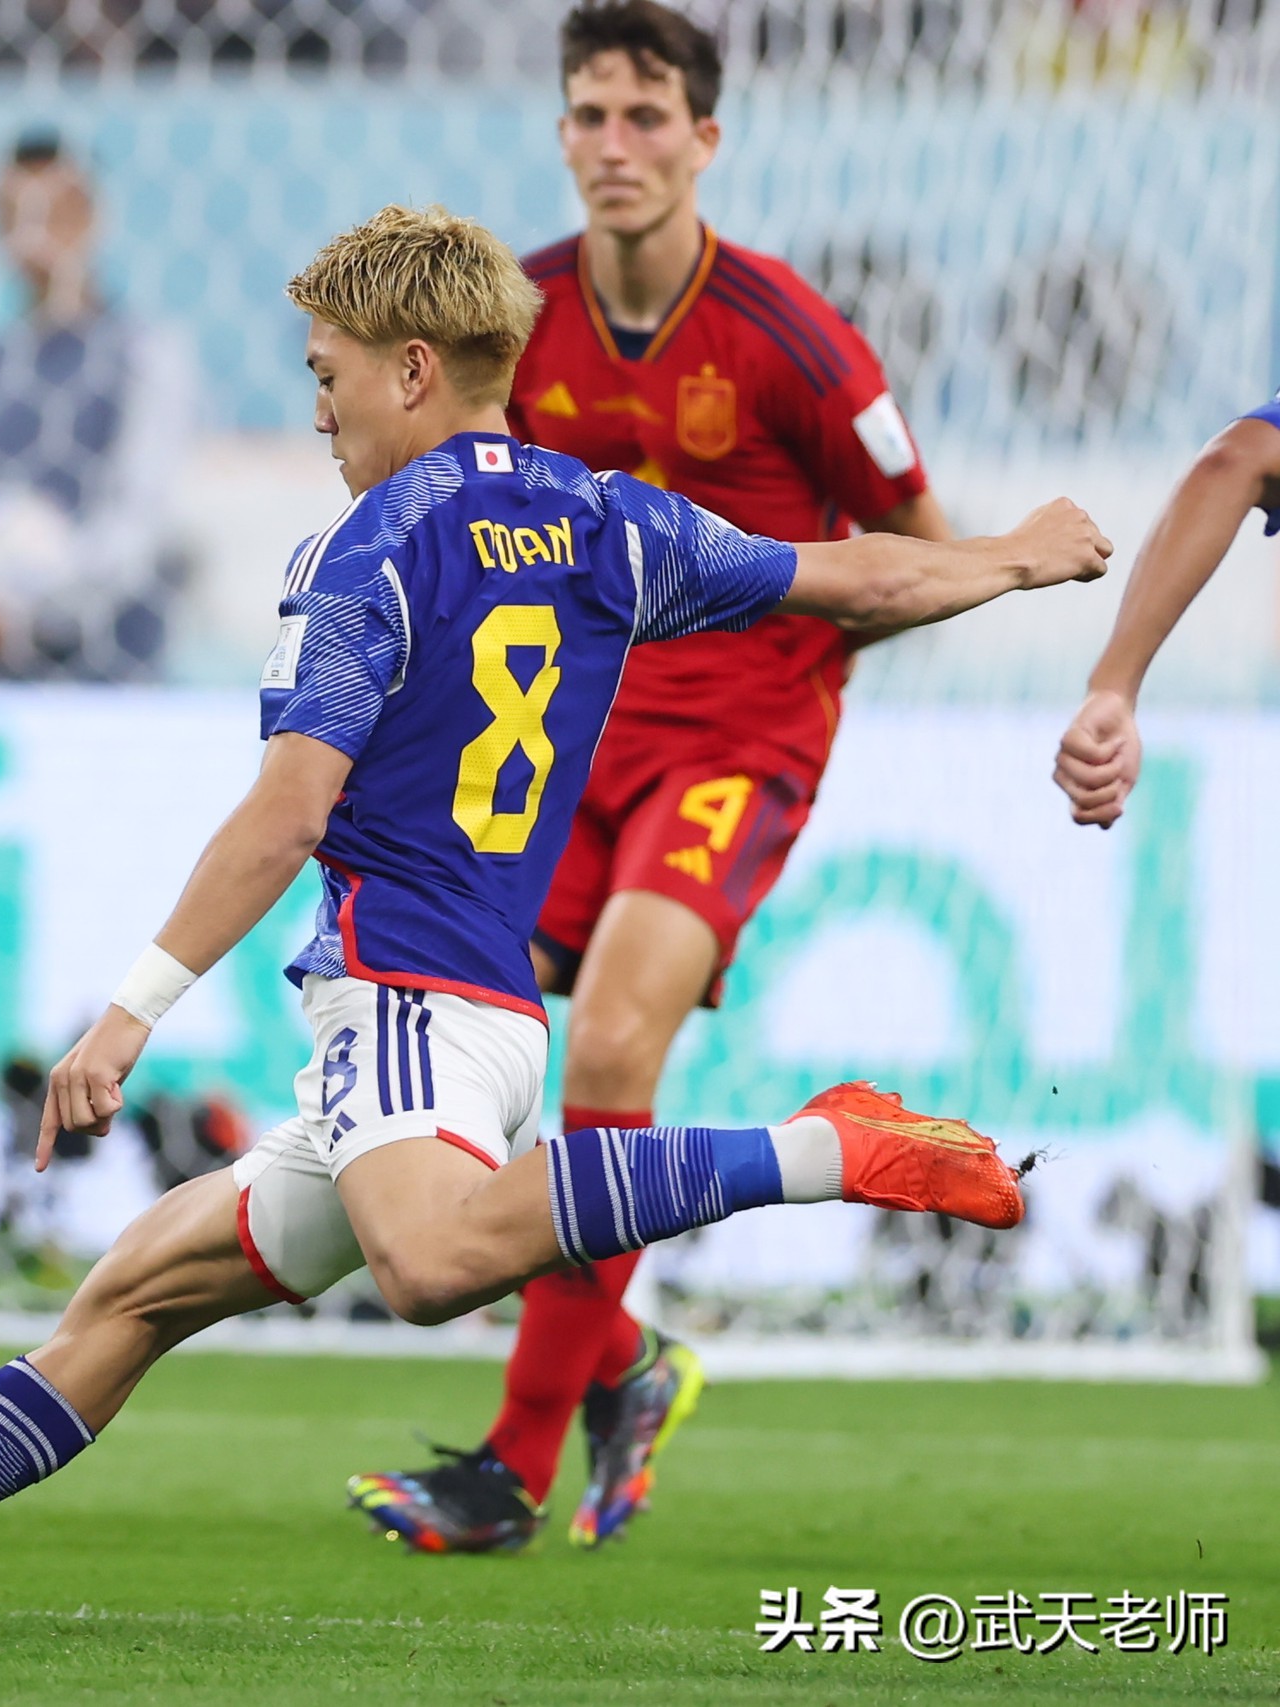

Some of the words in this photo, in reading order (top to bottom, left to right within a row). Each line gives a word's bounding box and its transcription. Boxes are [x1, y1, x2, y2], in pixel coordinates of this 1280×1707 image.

[468, 516, 575, 574] DOAN
[451, 604, 562, 854] 8
[678, 774, 754, 854] 4
[322, 1026, 359, 1117] 8
